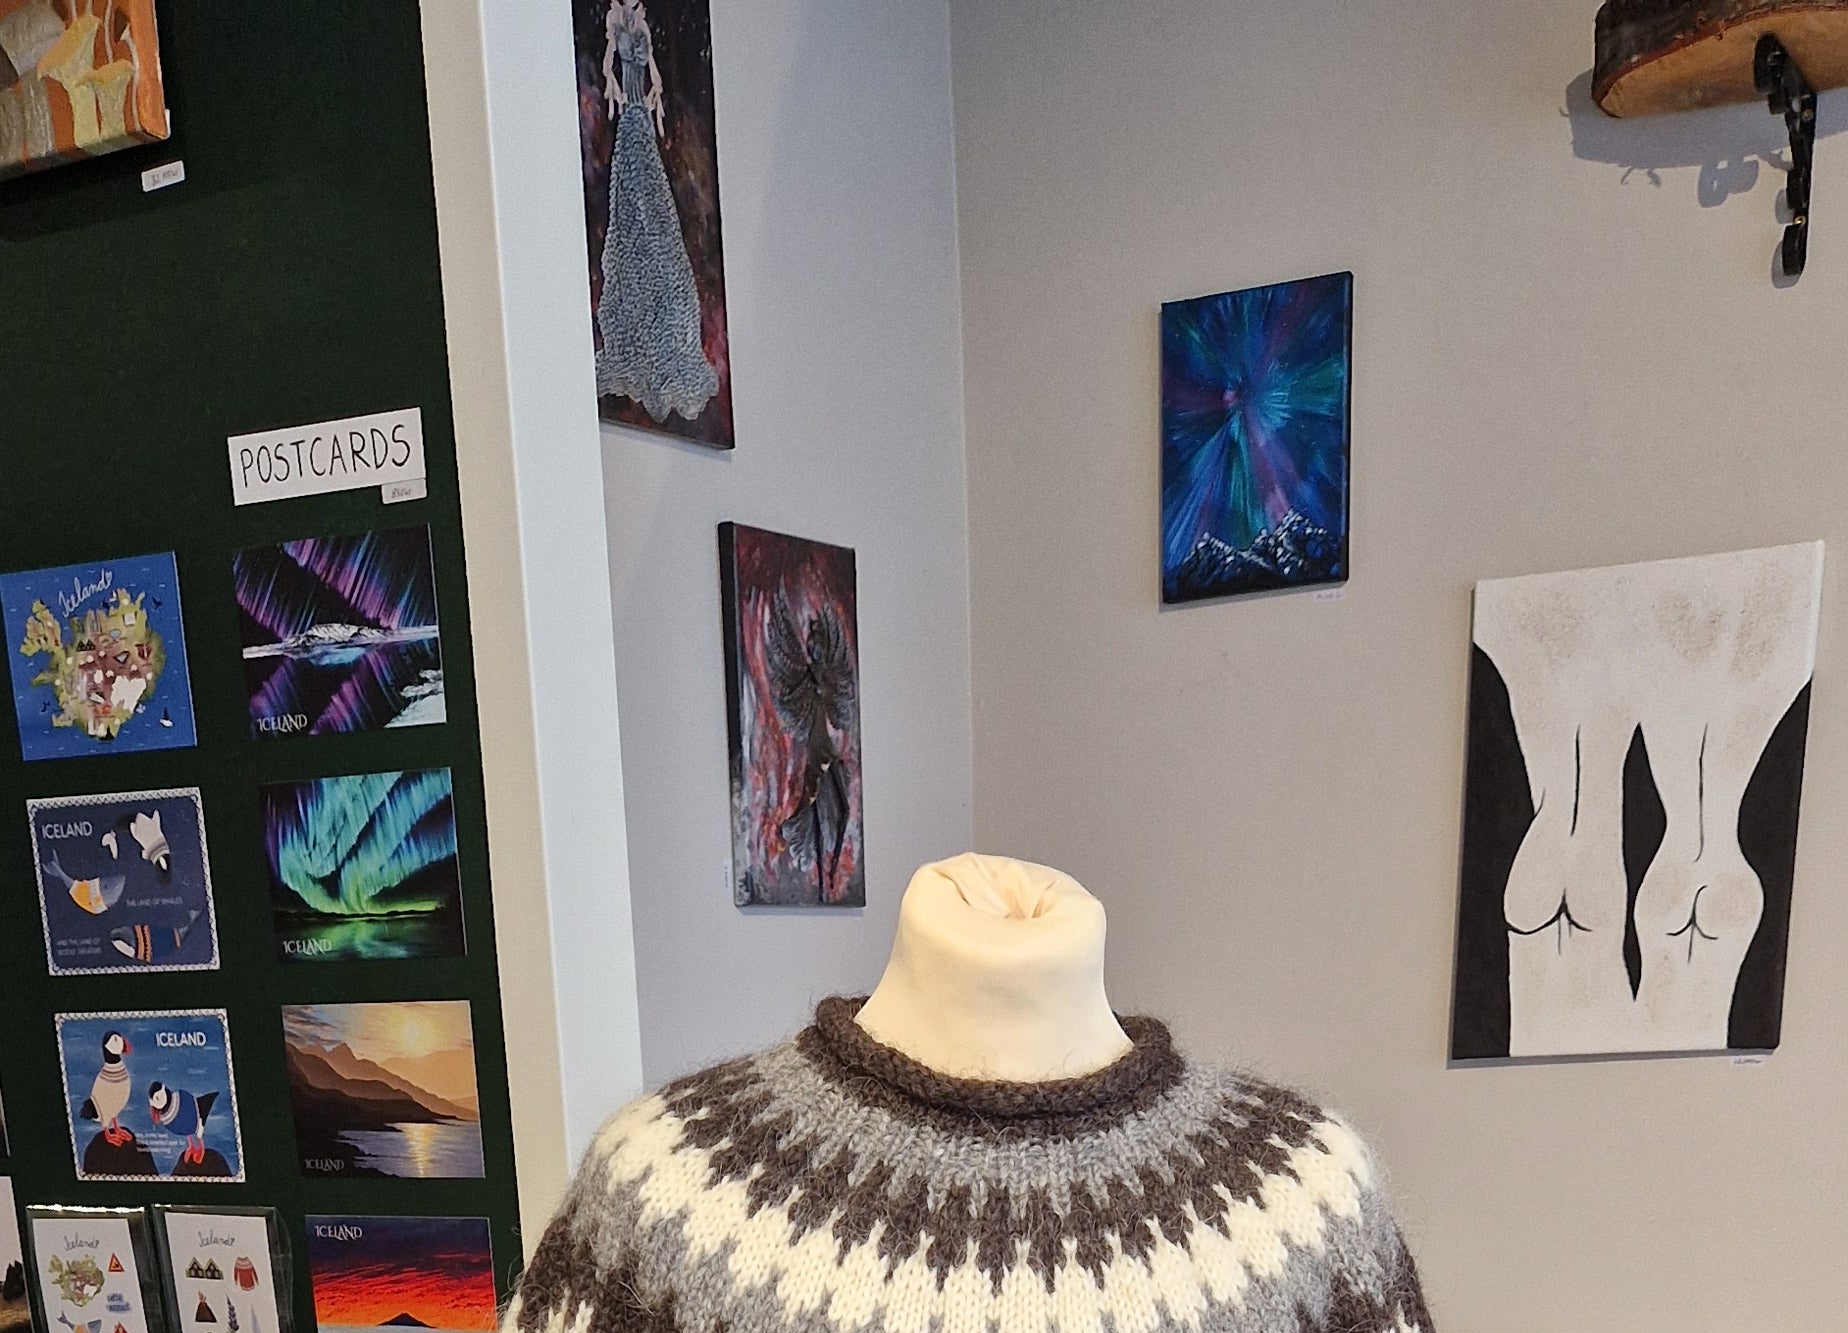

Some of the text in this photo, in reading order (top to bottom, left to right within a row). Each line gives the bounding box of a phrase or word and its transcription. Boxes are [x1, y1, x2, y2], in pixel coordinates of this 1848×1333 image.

[240, 424, 411, 488] POSTCARDS
[58, 567, 112, 618] Iceland
[256, 713, 308, 733] ICELAND
[41, 820, 93, 840] ICELAND
[281, 938, 332, 956] ICELAND
[155, 1031, 207, 1047] ICELAND
[303, 1158, 345, 1172] ICELAND
[314, 1224, 363, 1241] ICELAND
